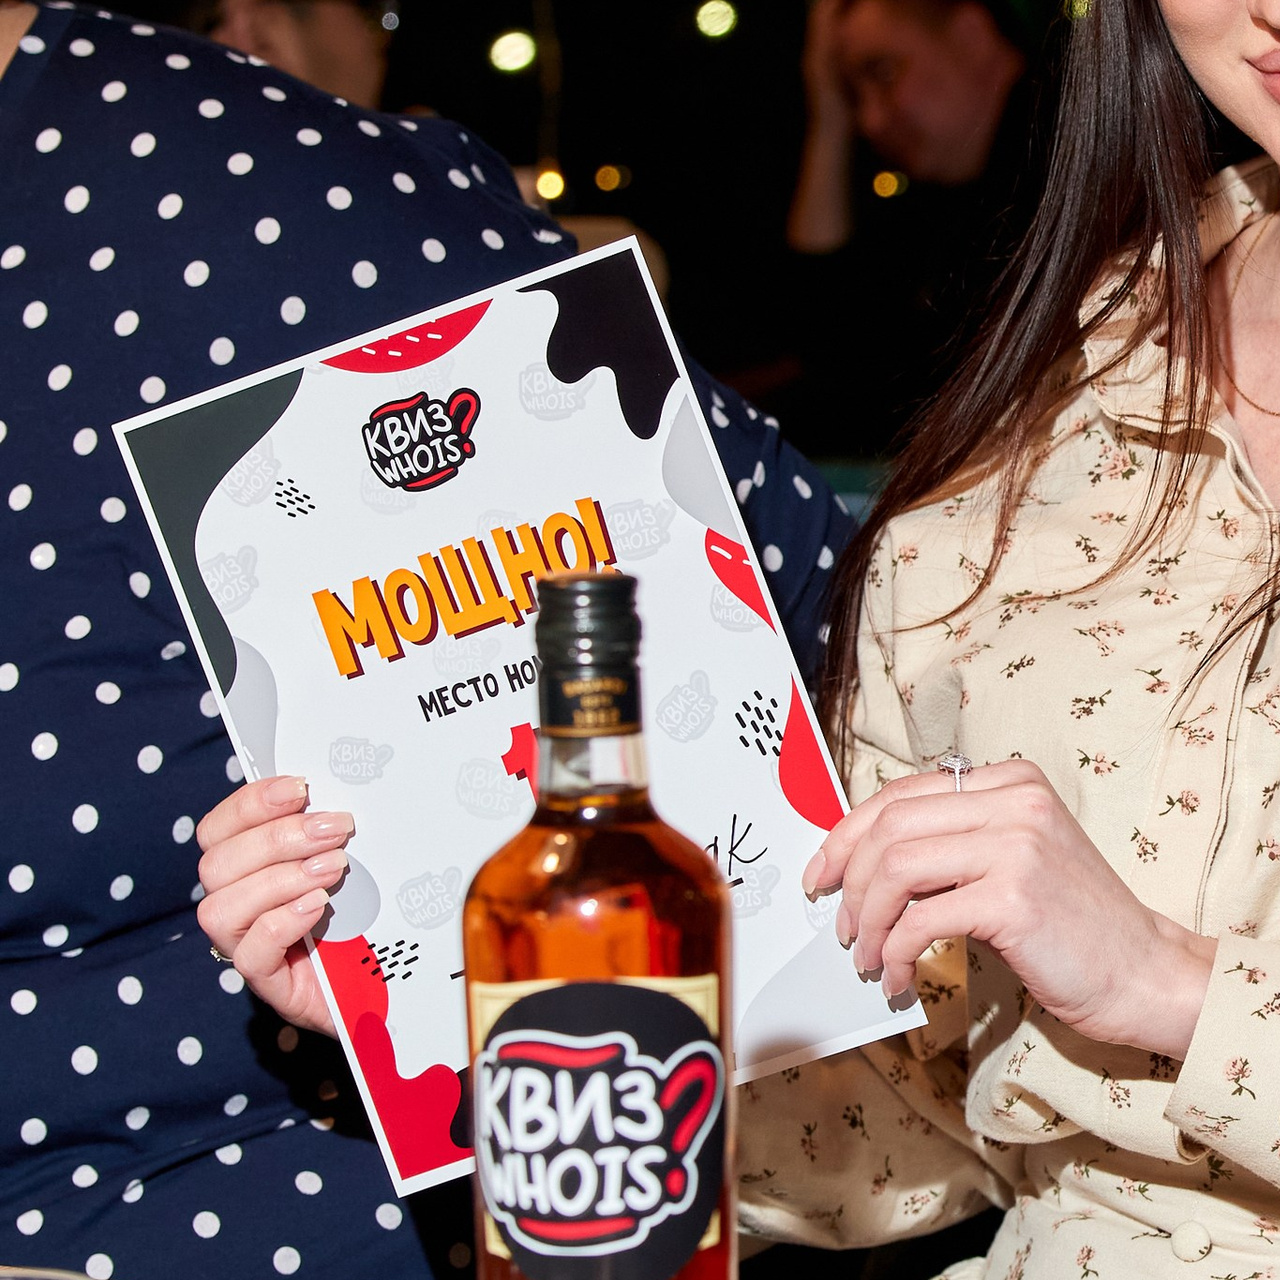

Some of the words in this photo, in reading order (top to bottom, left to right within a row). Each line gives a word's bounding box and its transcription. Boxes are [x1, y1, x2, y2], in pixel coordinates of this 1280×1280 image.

[365, 403, 452, 459] КВИЗ
[312, 497, 620, 680] МОЩНО!
[418, 673, 499, 722] МЕСТО
[503, 655, 542, 692] НО
[331, 744, 375, 761] КВИЗ
[331, 761, 376, 777] WHOIS
[481, 1066, 664, 1152] КВИЗ
